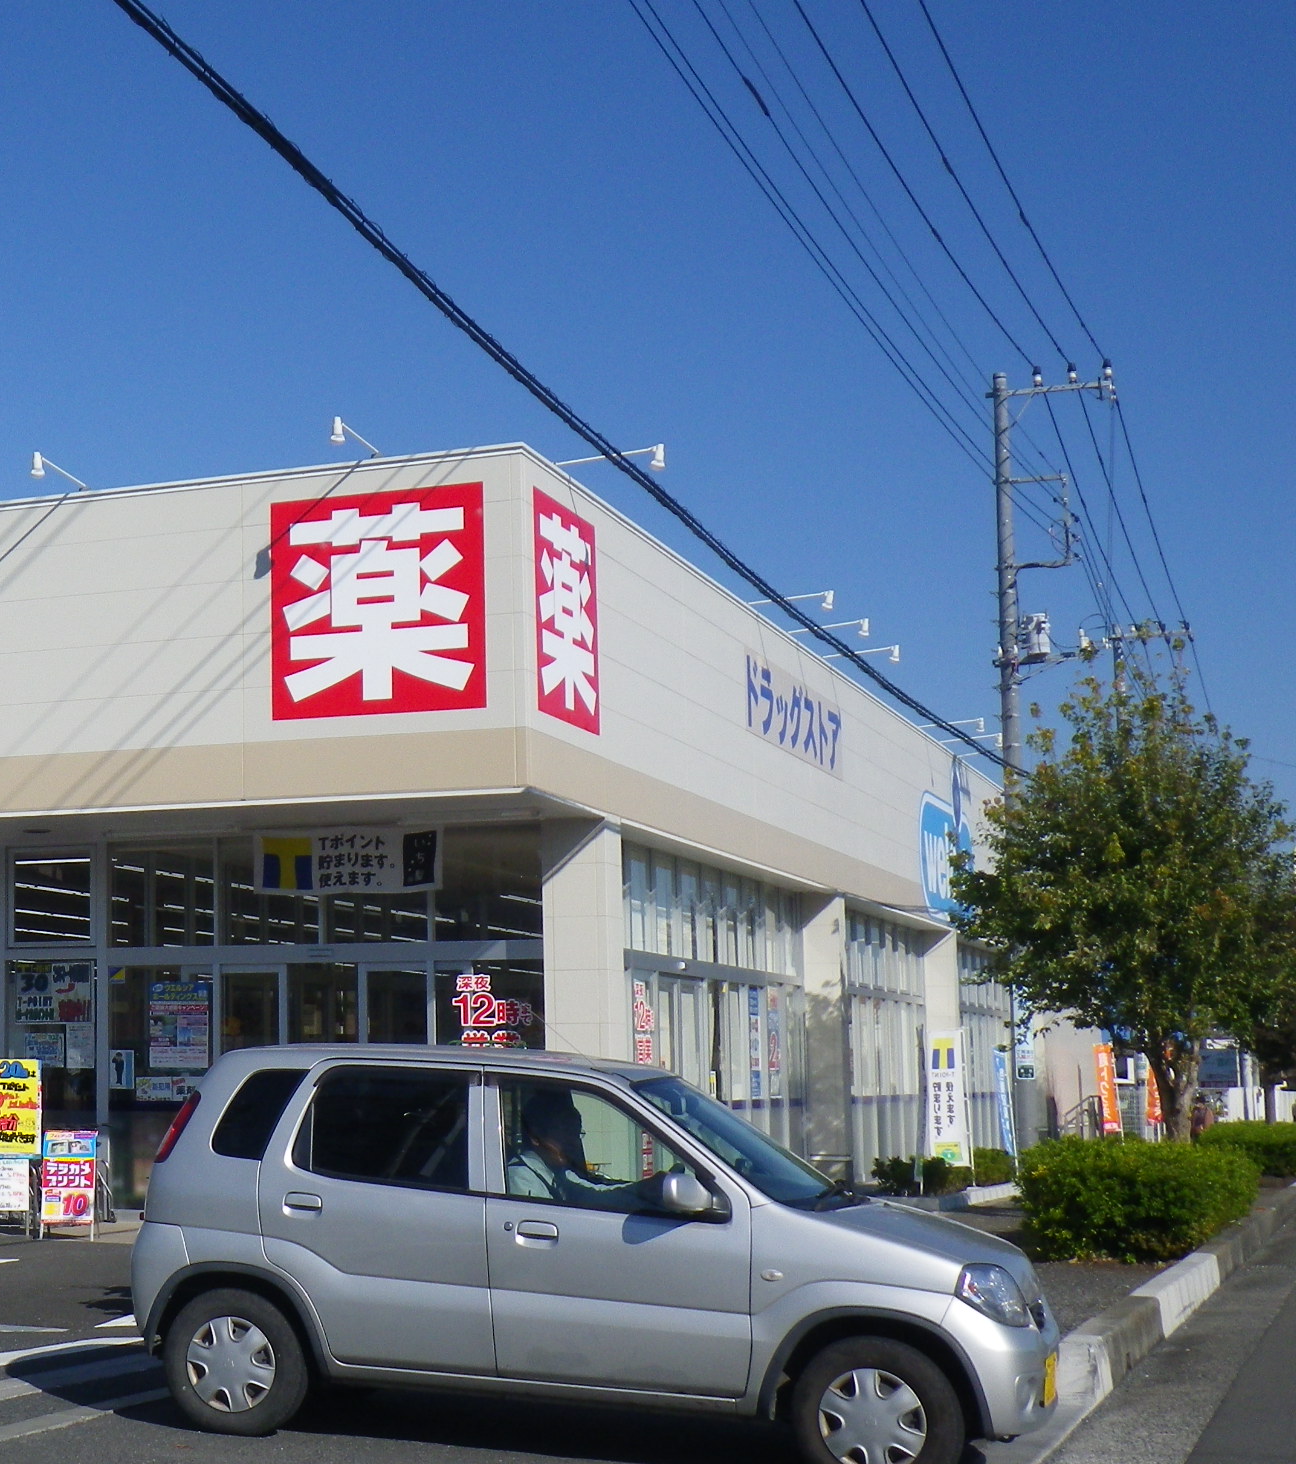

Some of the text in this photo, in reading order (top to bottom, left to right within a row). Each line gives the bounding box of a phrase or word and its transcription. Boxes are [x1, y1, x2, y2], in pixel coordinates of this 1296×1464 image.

[283, 502, 475, 702] 薬
[538, 512, 597, 716] 薬
[746, 654, 842, 771] ドラッグストア
[318, 834, 385, 850] Tポイント
[318, 871, 382, 888] 使えます。
[457, 974, 491, 991] 深夜
[452, 992, 533, 1026] 12時まで
